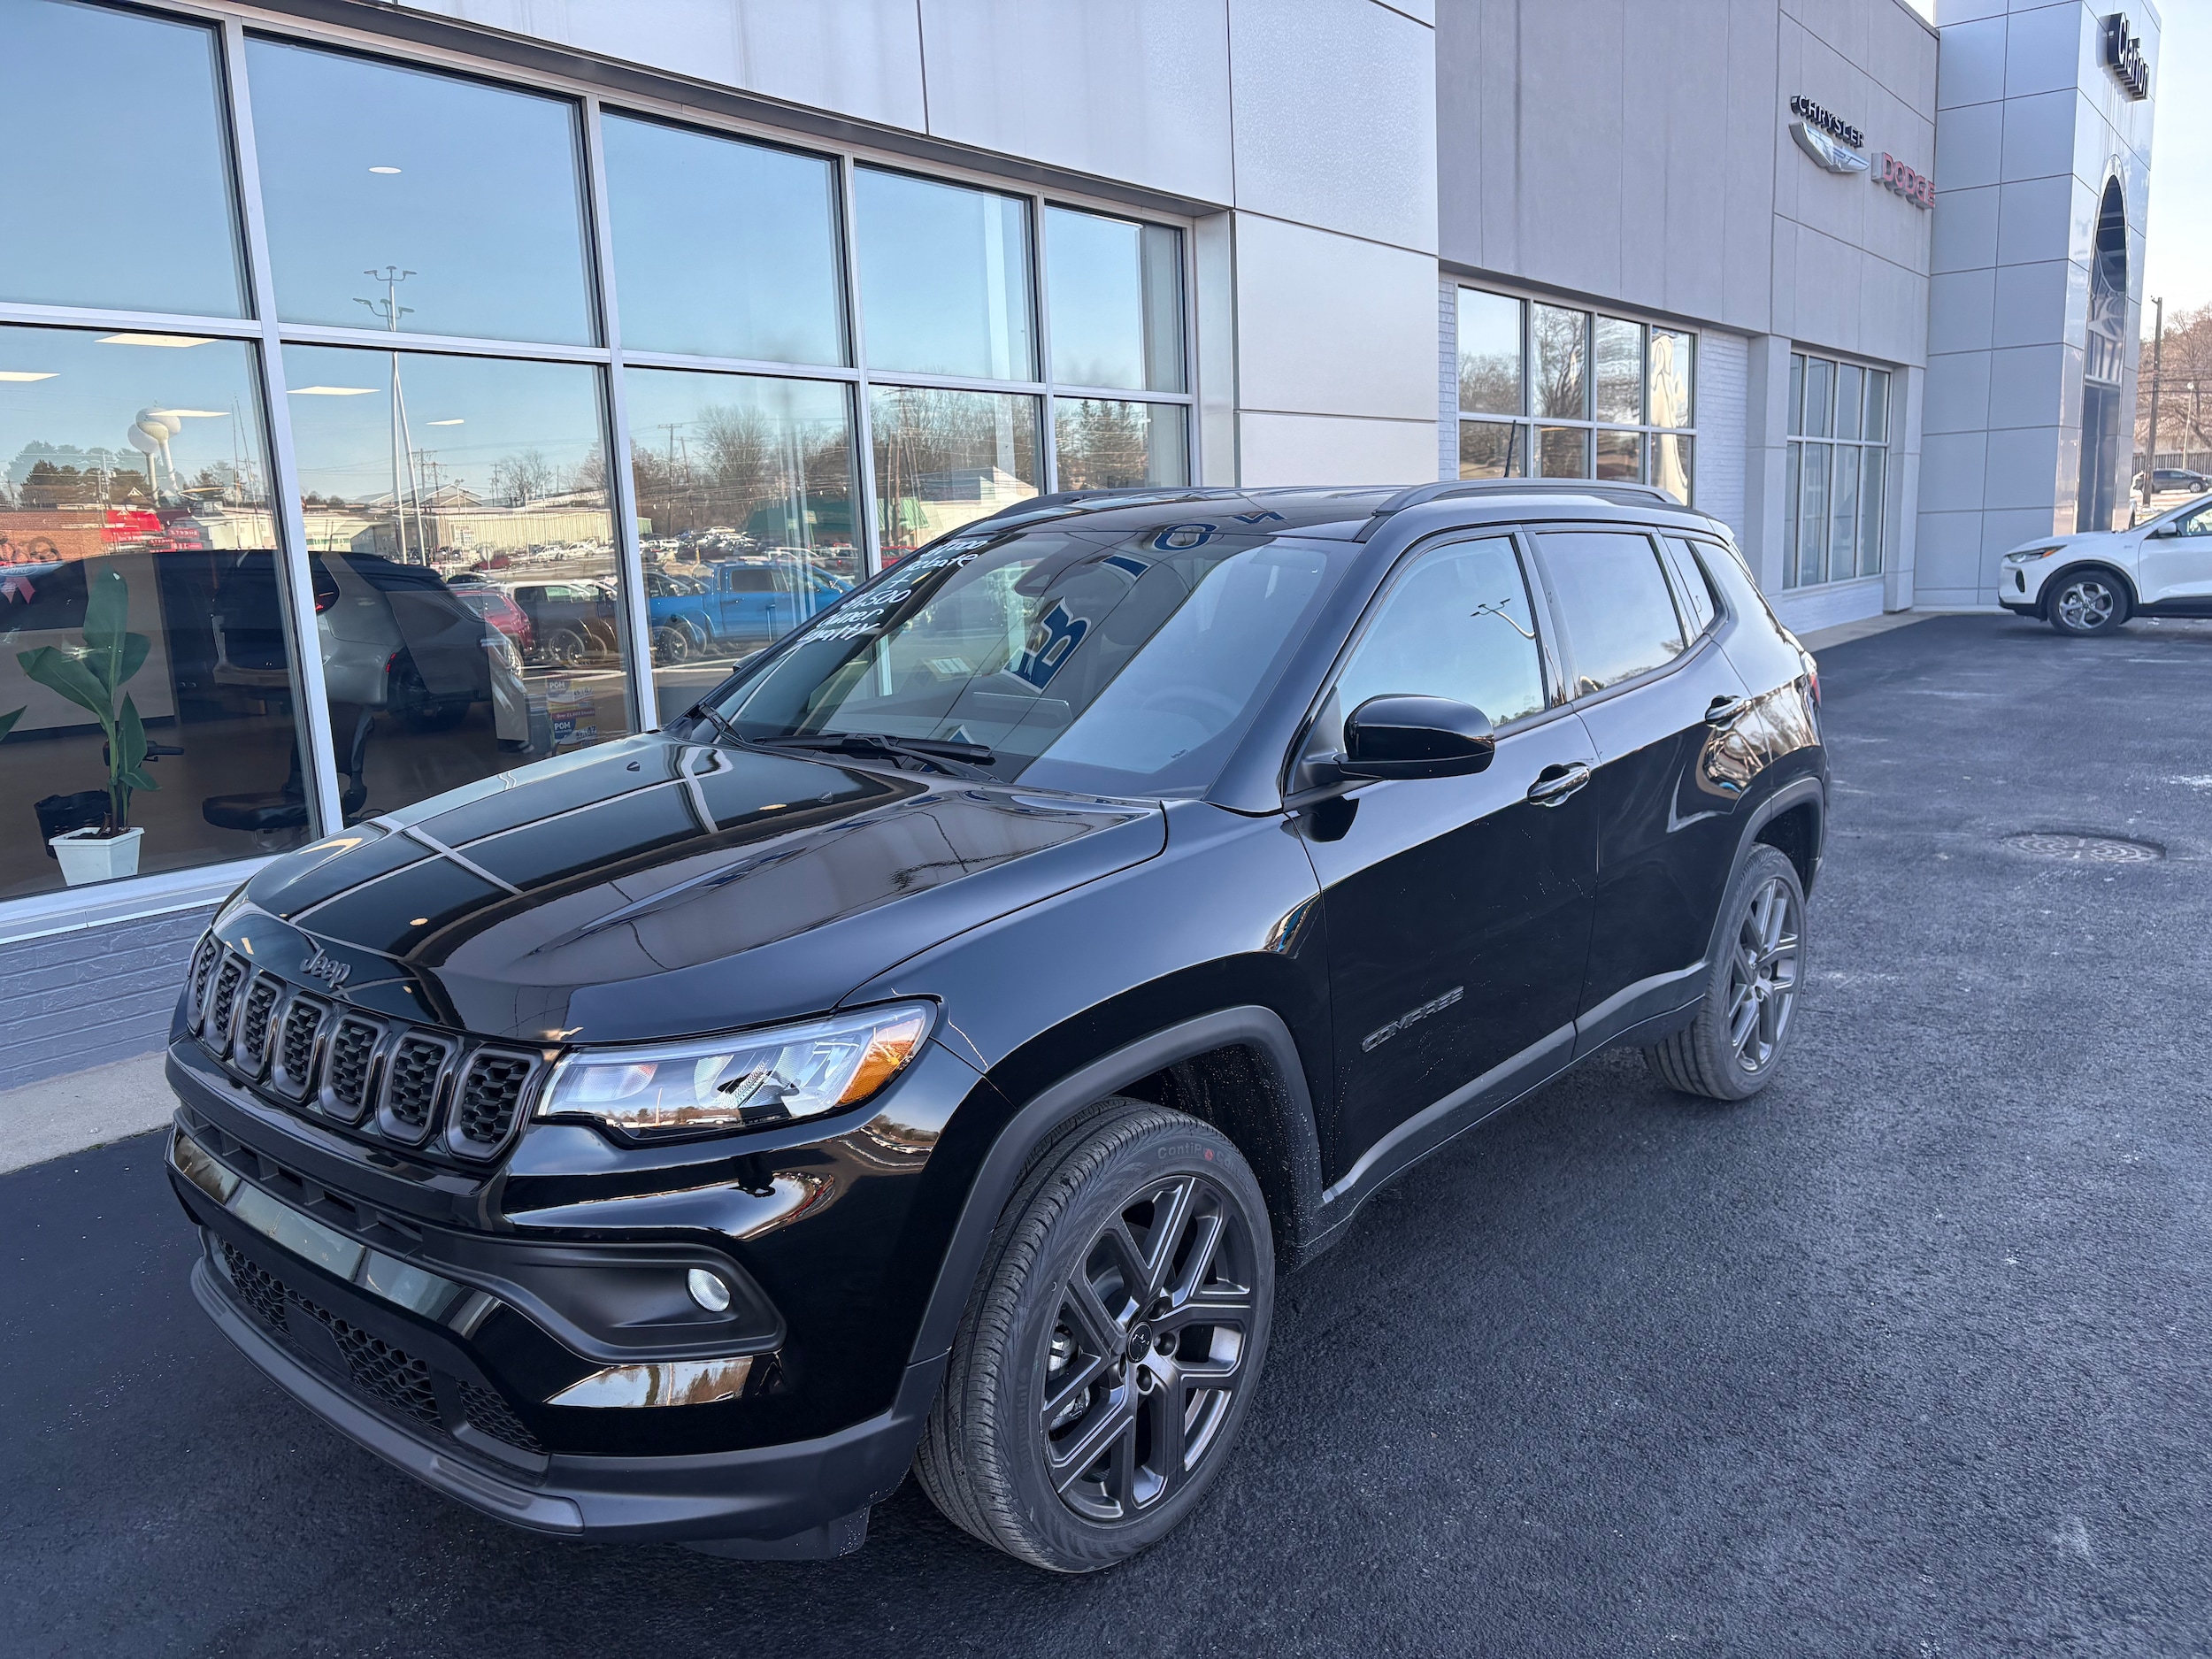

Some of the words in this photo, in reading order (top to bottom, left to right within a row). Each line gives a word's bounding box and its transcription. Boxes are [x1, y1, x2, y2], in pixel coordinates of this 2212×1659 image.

[2113, 12, 2150, 100] Clarion
[1793, 94, 1865, 148] CHRYSLER
[1877, 152, 1936, 209] DODGE
[554, 721, 571, 730] POM
[299, 948, 351, 988] Jeep
[1361, 986, 1464, 1053] COMPASS
